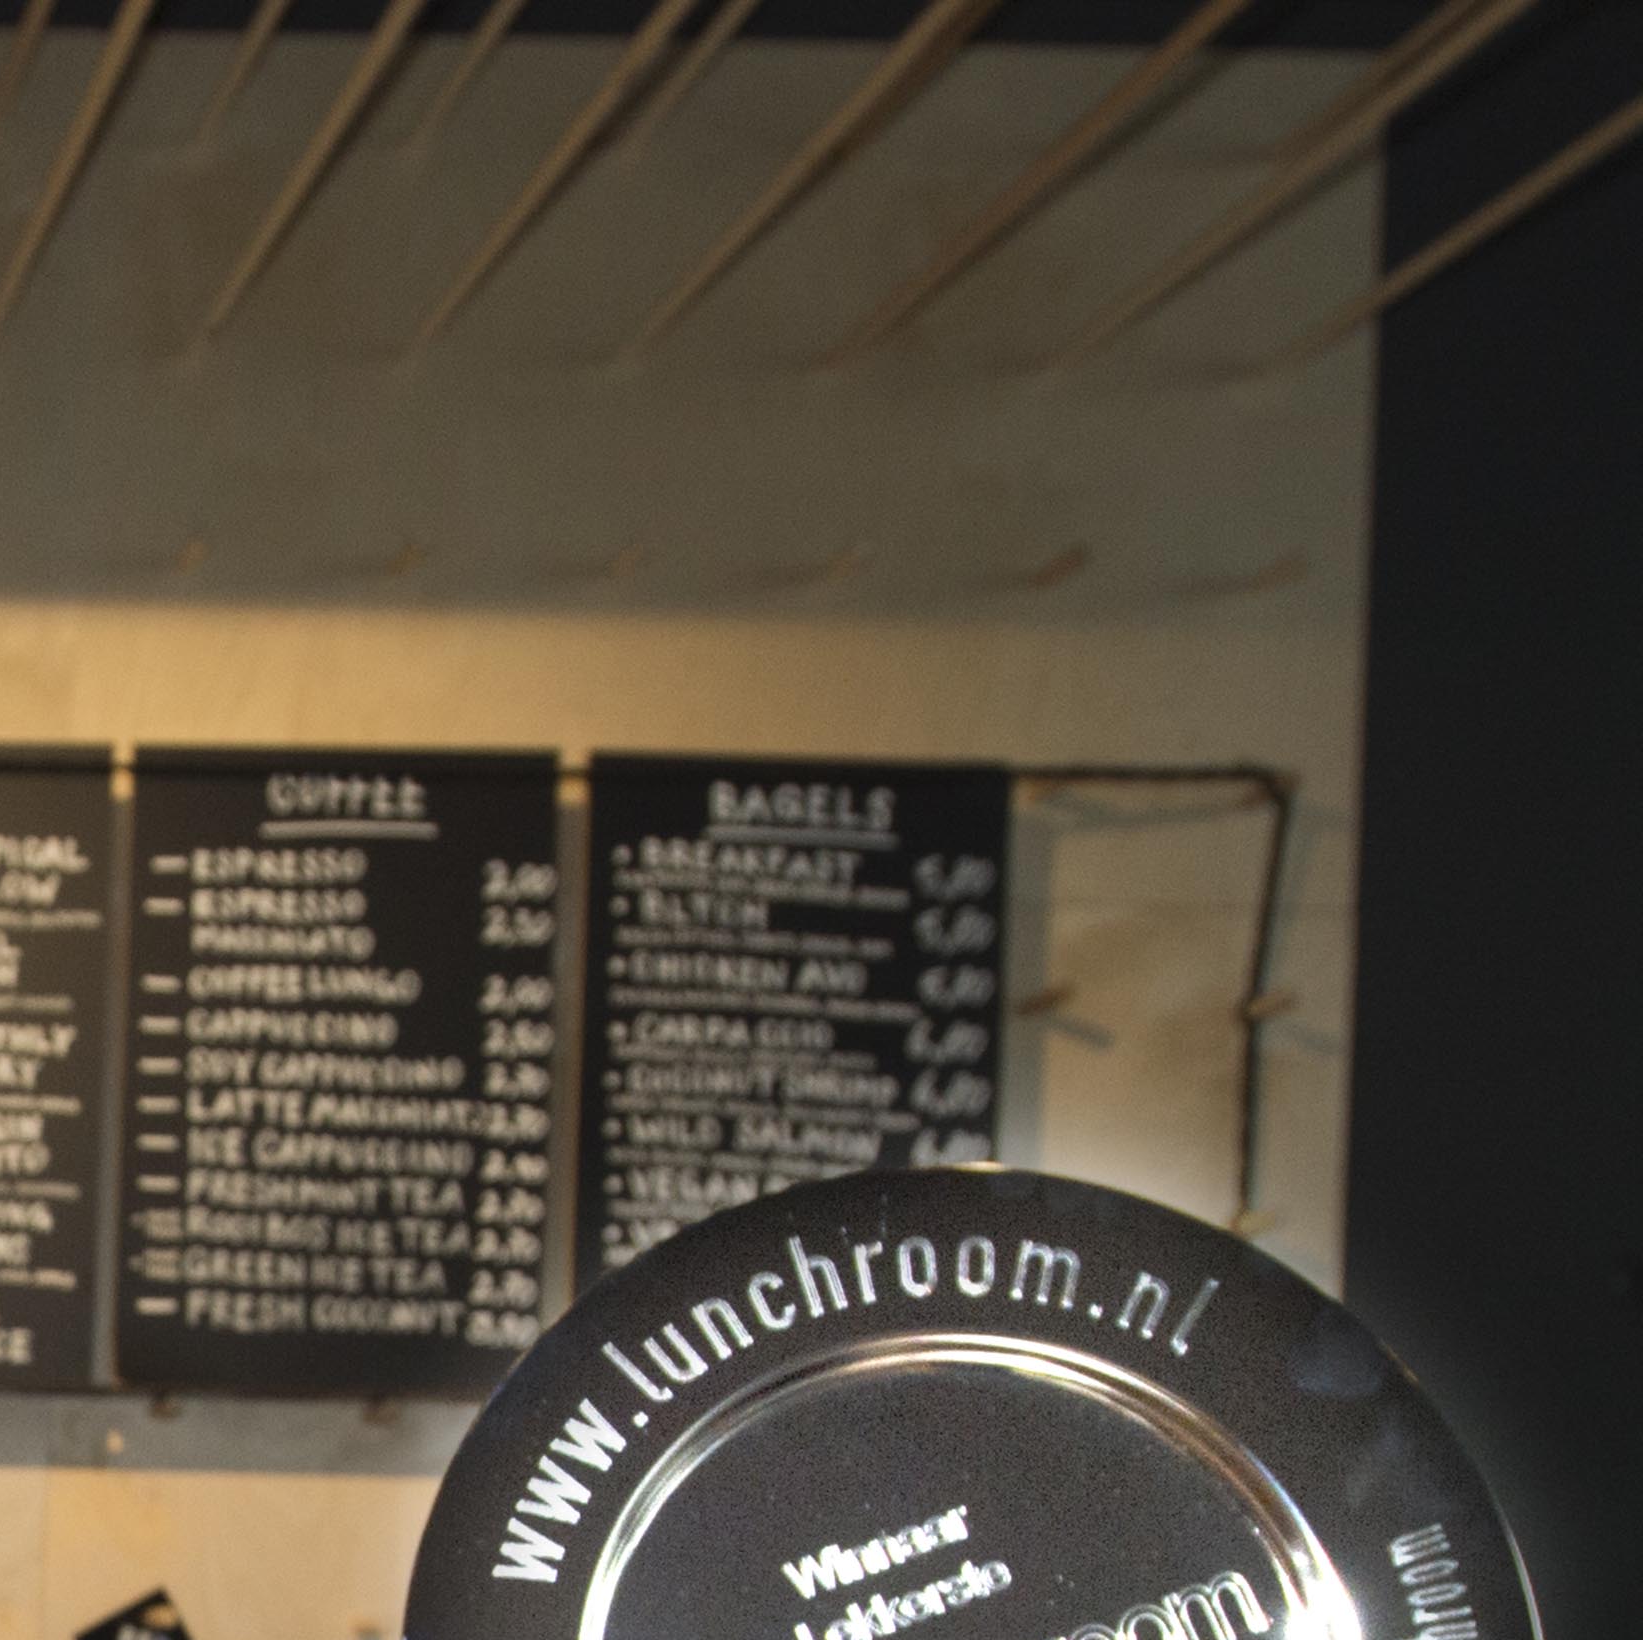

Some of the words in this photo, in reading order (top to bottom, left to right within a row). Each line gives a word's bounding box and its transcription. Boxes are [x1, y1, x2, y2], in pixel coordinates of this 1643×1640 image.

[267, 775, 428, 818] COFFEE
[707, 779, 898, 831] BAGELS
[190, 847, 368, 883] ESPRESSO
[639, 834, 865, 884] BREAKFAST
[190, 888, 368, 921] ESPRESSO
[188, 966, 303, 1001] COFFEE
[628, 950, 790, 993] CHICKEN
[186, 1008, 400, 1048] CAPPUCCINO
[186, 1051, 254, 1084] SOY
[260, 1053, 467, 1090] CAPPUCCINO
[188, 1090, 303, 1124] LATTE
[254, 1132, 475, 1171] CAPPUCCINO
[187, 1168, 296, 1206] FRESH
[392, 1178, 467, 1214] TEA
[403, 1219, 471, 1254] TEA
[185, 1248, 307, 1285] GREEN
[370, 1258, 447, 1291] TEA
[186, 1295, 306, 1331] FRESH
[492, 1235, 1220, 1583] www.lunchroom.nl
